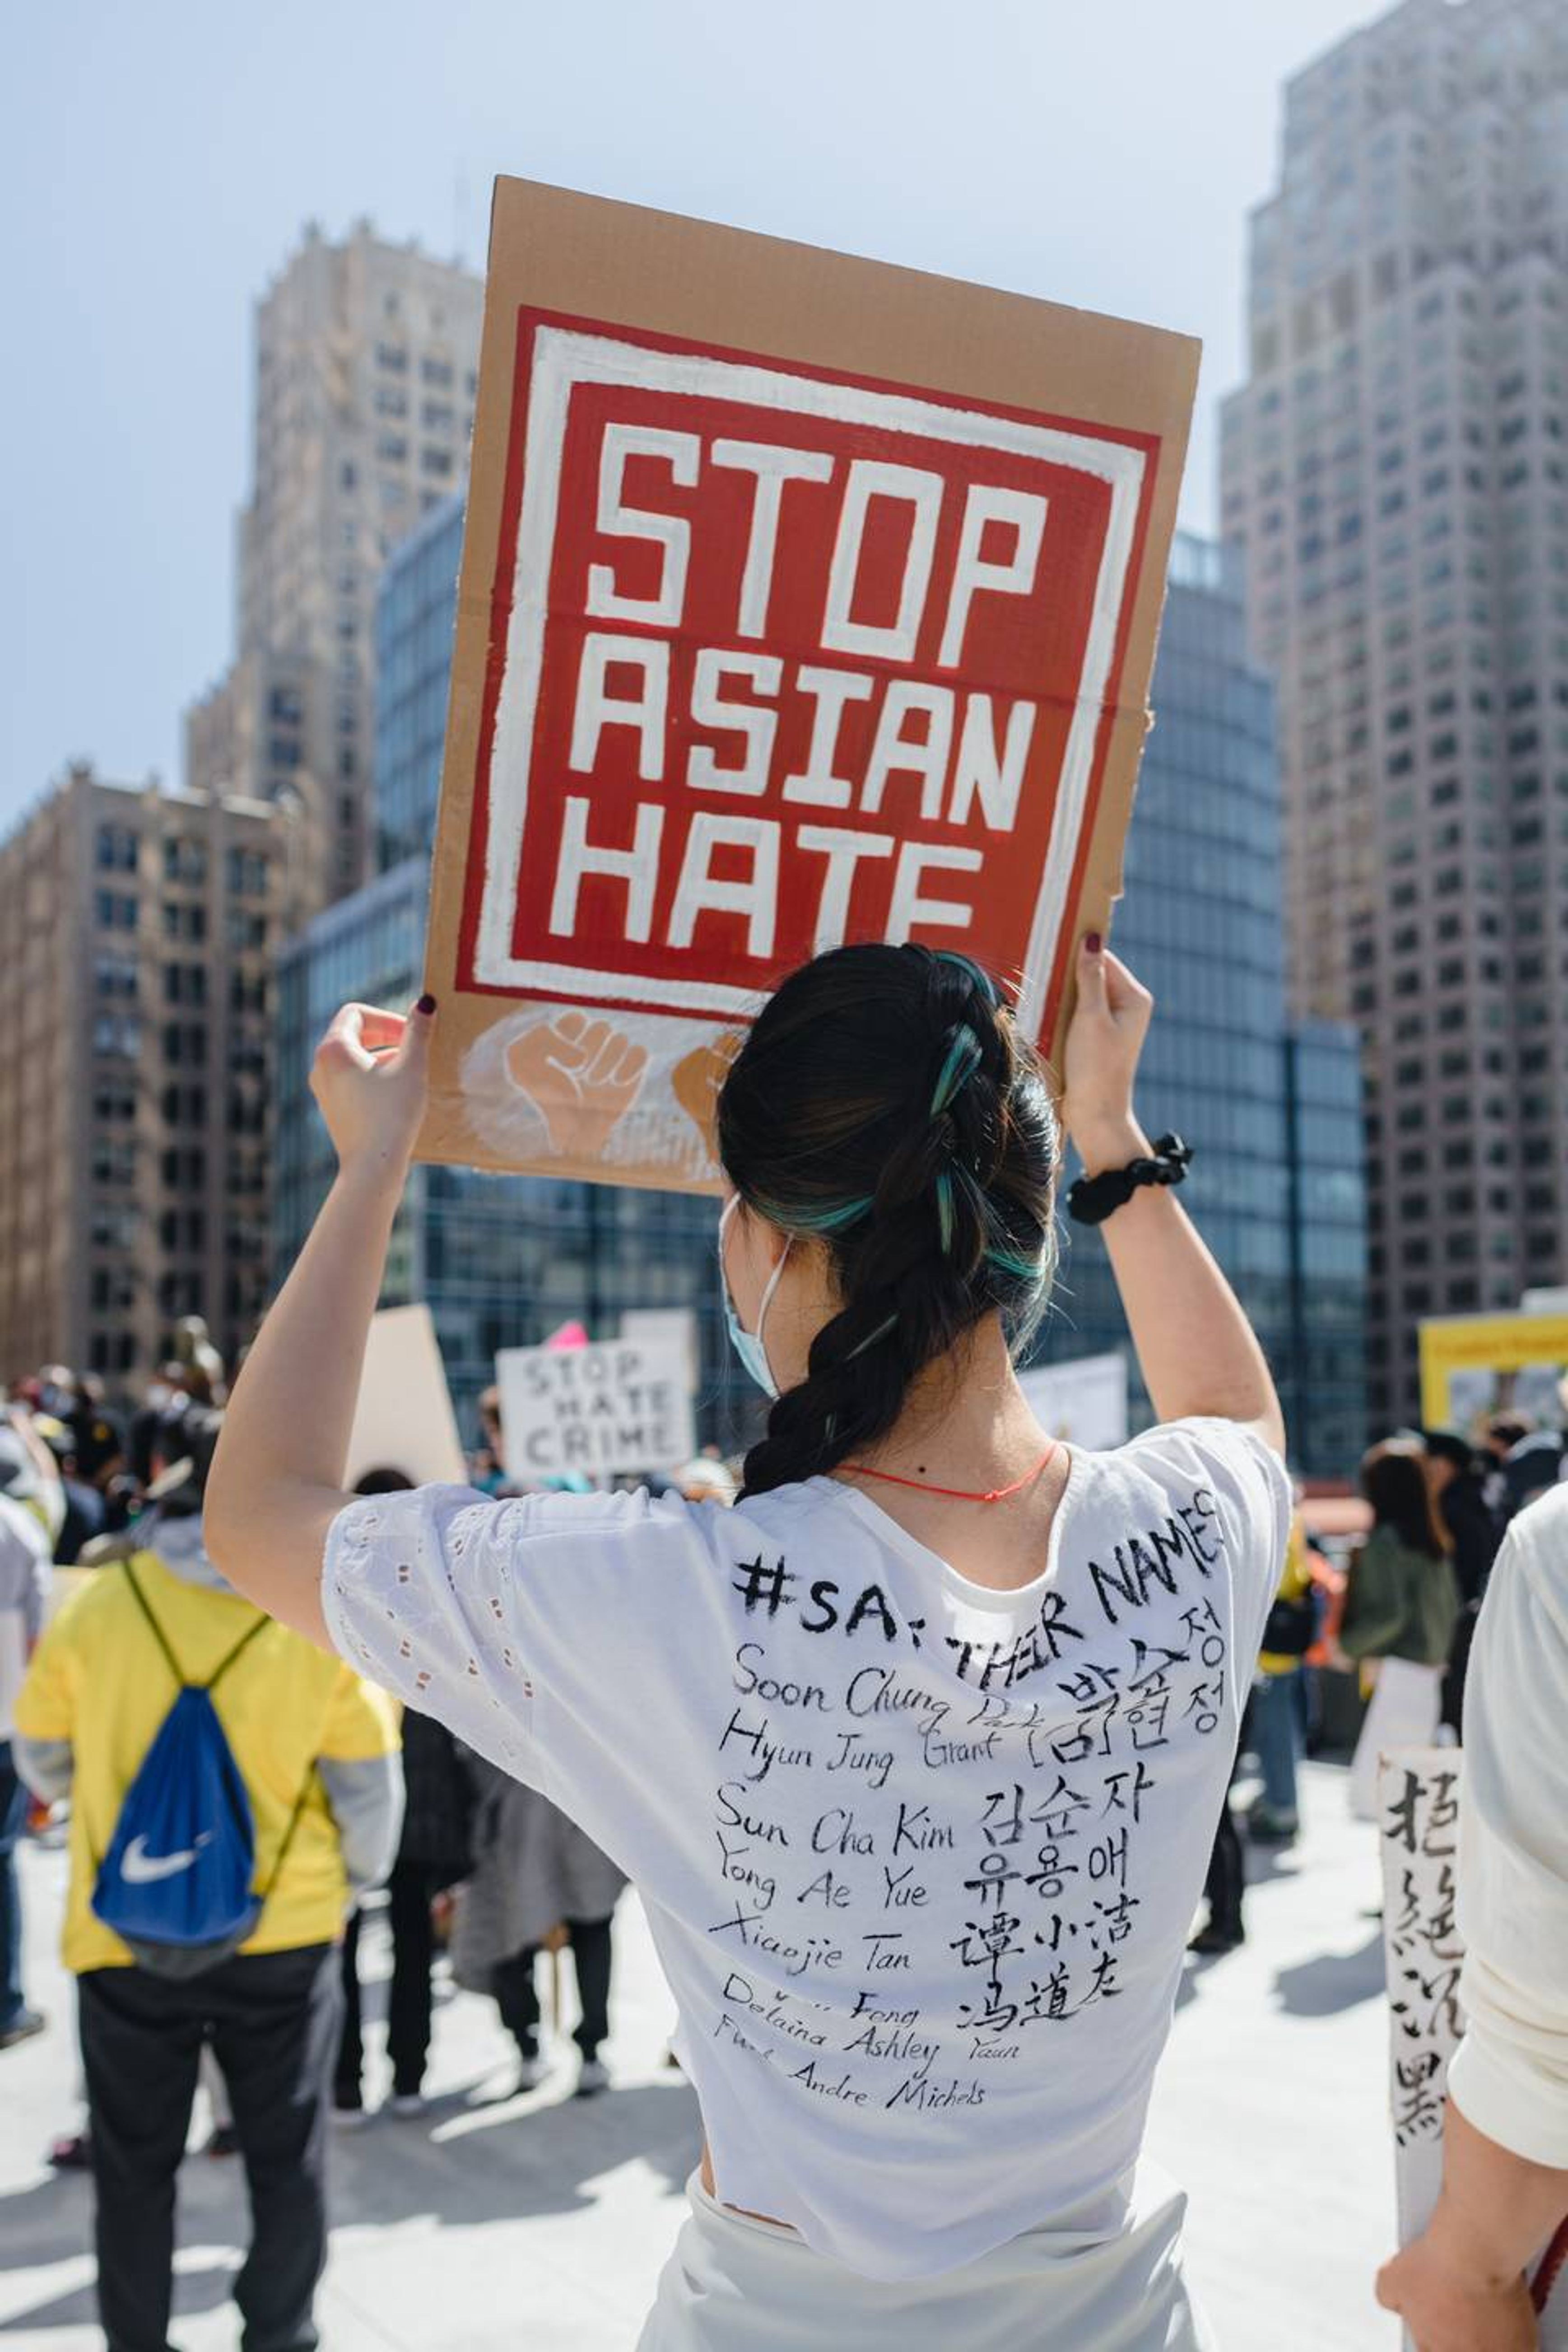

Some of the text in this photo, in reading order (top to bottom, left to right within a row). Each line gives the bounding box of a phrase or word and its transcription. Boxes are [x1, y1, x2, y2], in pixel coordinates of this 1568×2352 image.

[585, 422, 1049, 668] STOP
[568, 633, 1037, 833] ASIAN
[549, 796, 984, 959] HATE
[524, 1351, 641, 1397] STOP
[554, 1381, 672, 1418] HATE
[524, 1425, 673, 1465] CRIME
[734, 1643, 834, 1713] Soon
[846, 1667, 952, 1737] Chung
[719, 1708, 1003, 1789] Hyun Jung Grant
[716, 1782, 956, 1856] Sun Cha Kim
[716, 1830, 929, 1910] Yong Ae Yue
[708, 1899, 911, 1976] Xiaojie Tan
[787, 2061, 986, 2110] Andre Michels
[842, 2026, 940, 2080] Ashley
